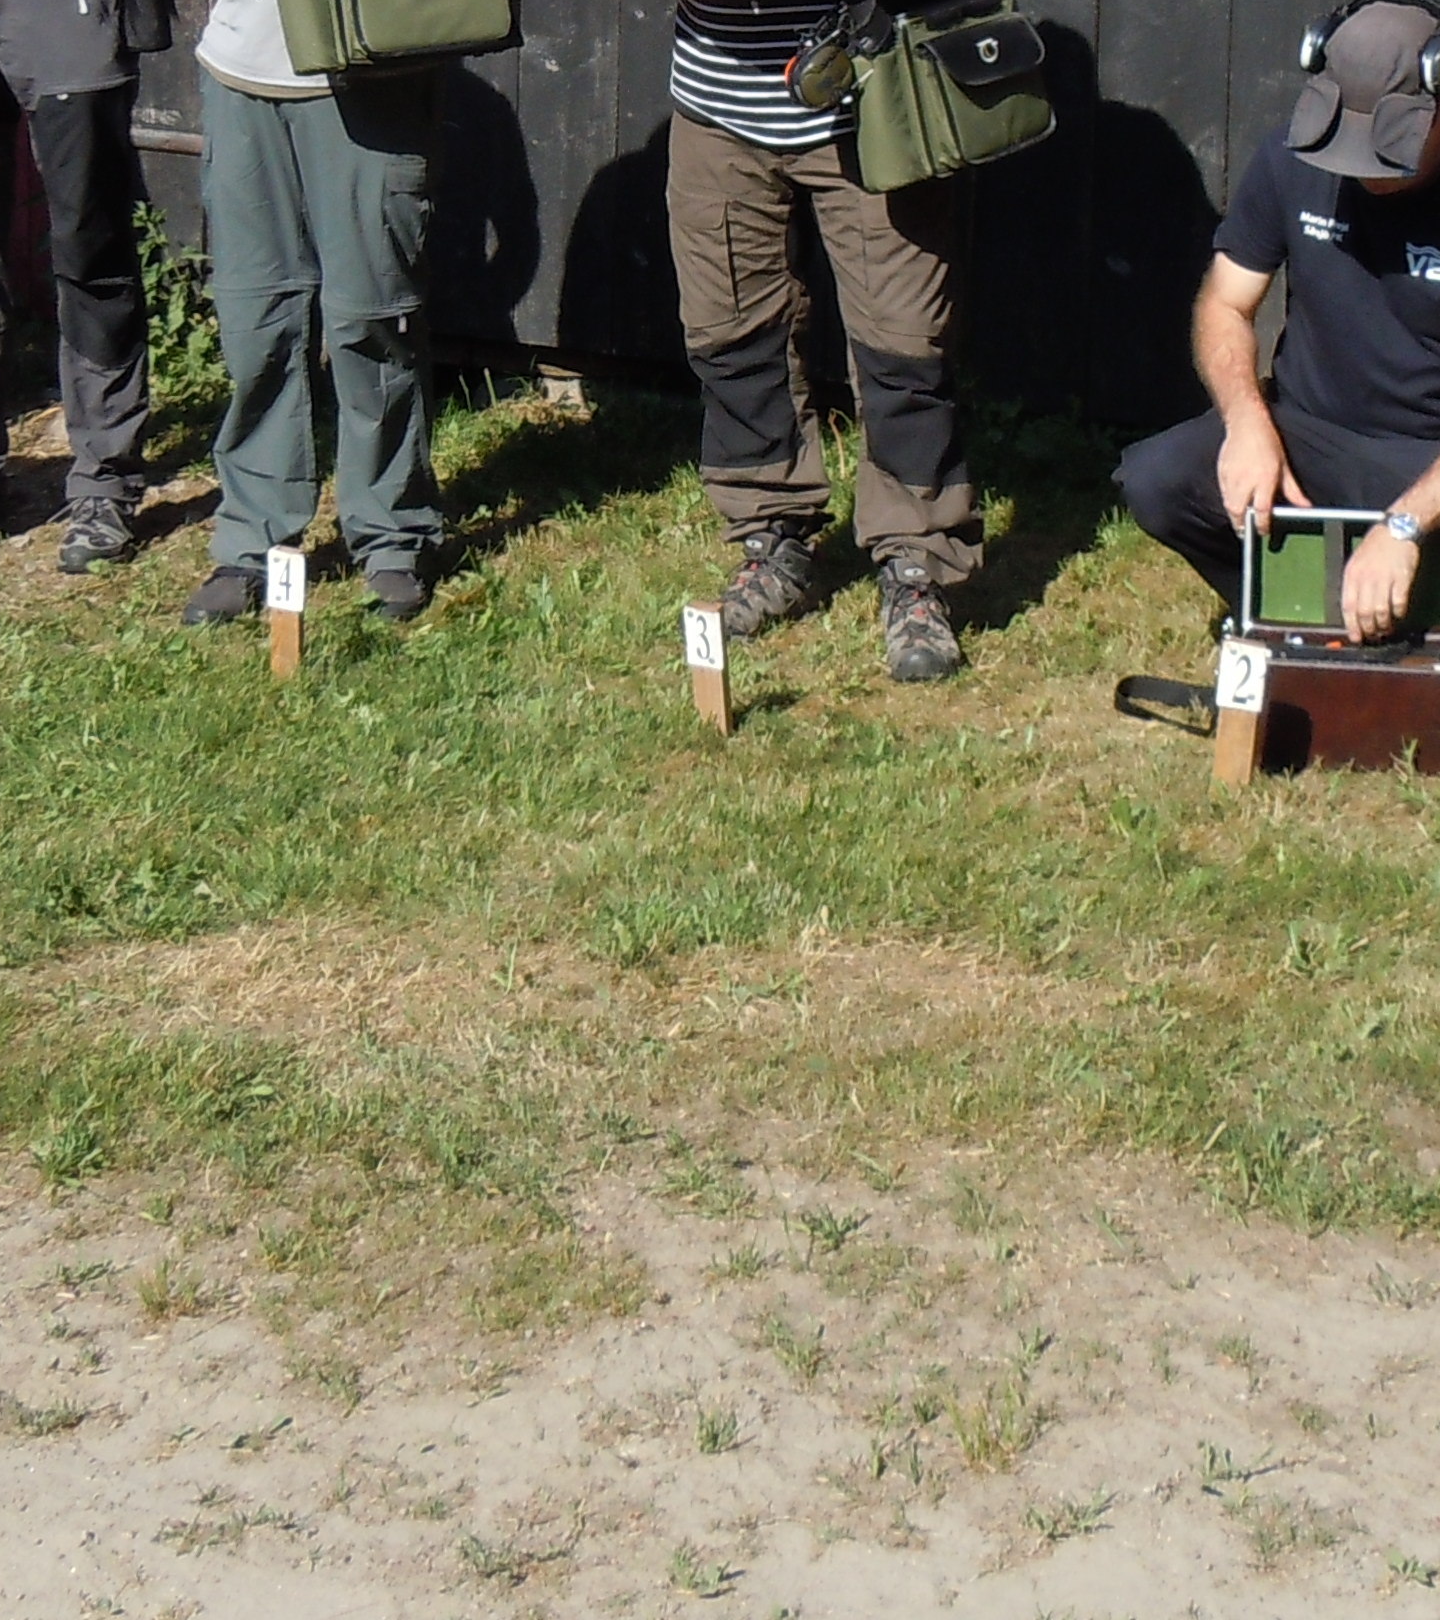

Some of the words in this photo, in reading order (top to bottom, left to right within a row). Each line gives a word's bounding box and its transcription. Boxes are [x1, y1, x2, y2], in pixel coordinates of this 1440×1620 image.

[279, 557, 292, 601] 4
[696, 615, 711, 660] 3
[1233, 654, 1252, 704] 2
